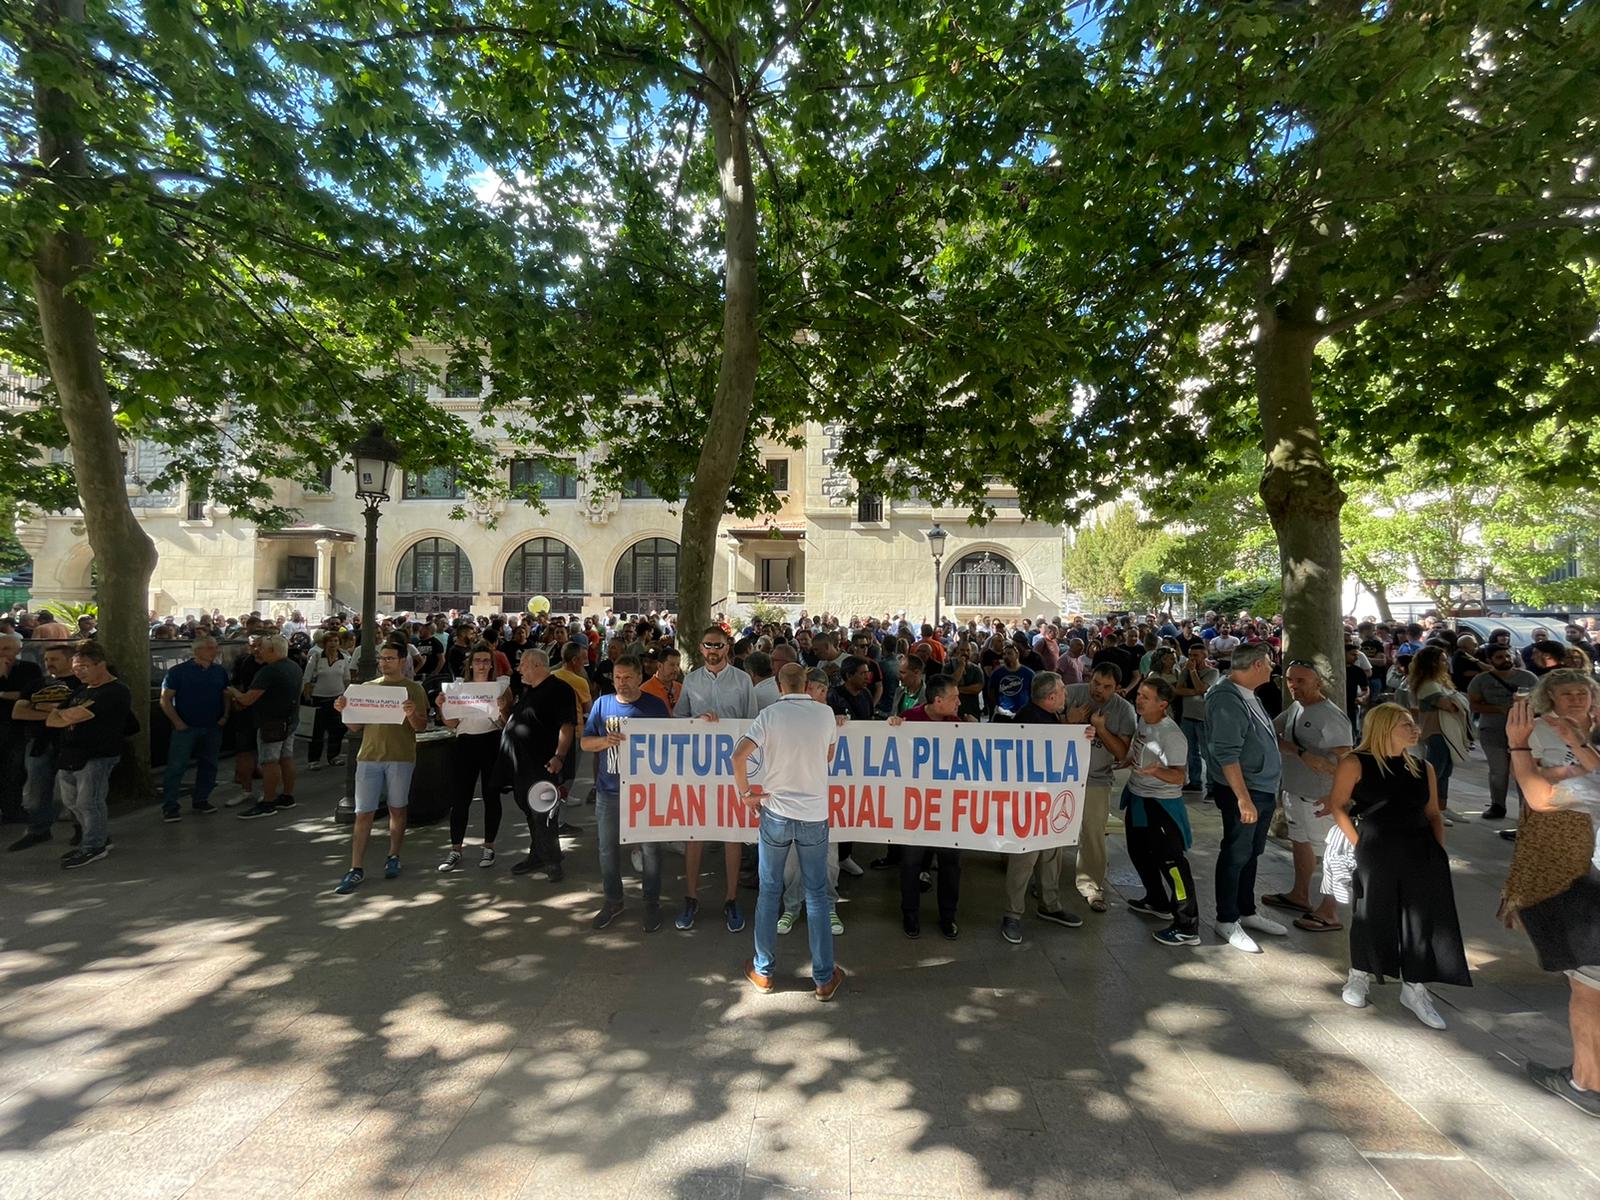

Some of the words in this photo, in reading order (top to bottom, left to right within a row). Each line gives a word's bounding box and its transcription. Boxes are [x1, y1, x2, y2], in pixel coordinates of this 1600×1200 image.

[863, 736, 901, 777] LA
[912, 737, 1079, 783] PLANTILLA
[629, 783, 705, 827] PLAN
[903, 787, 942, 831] DE
